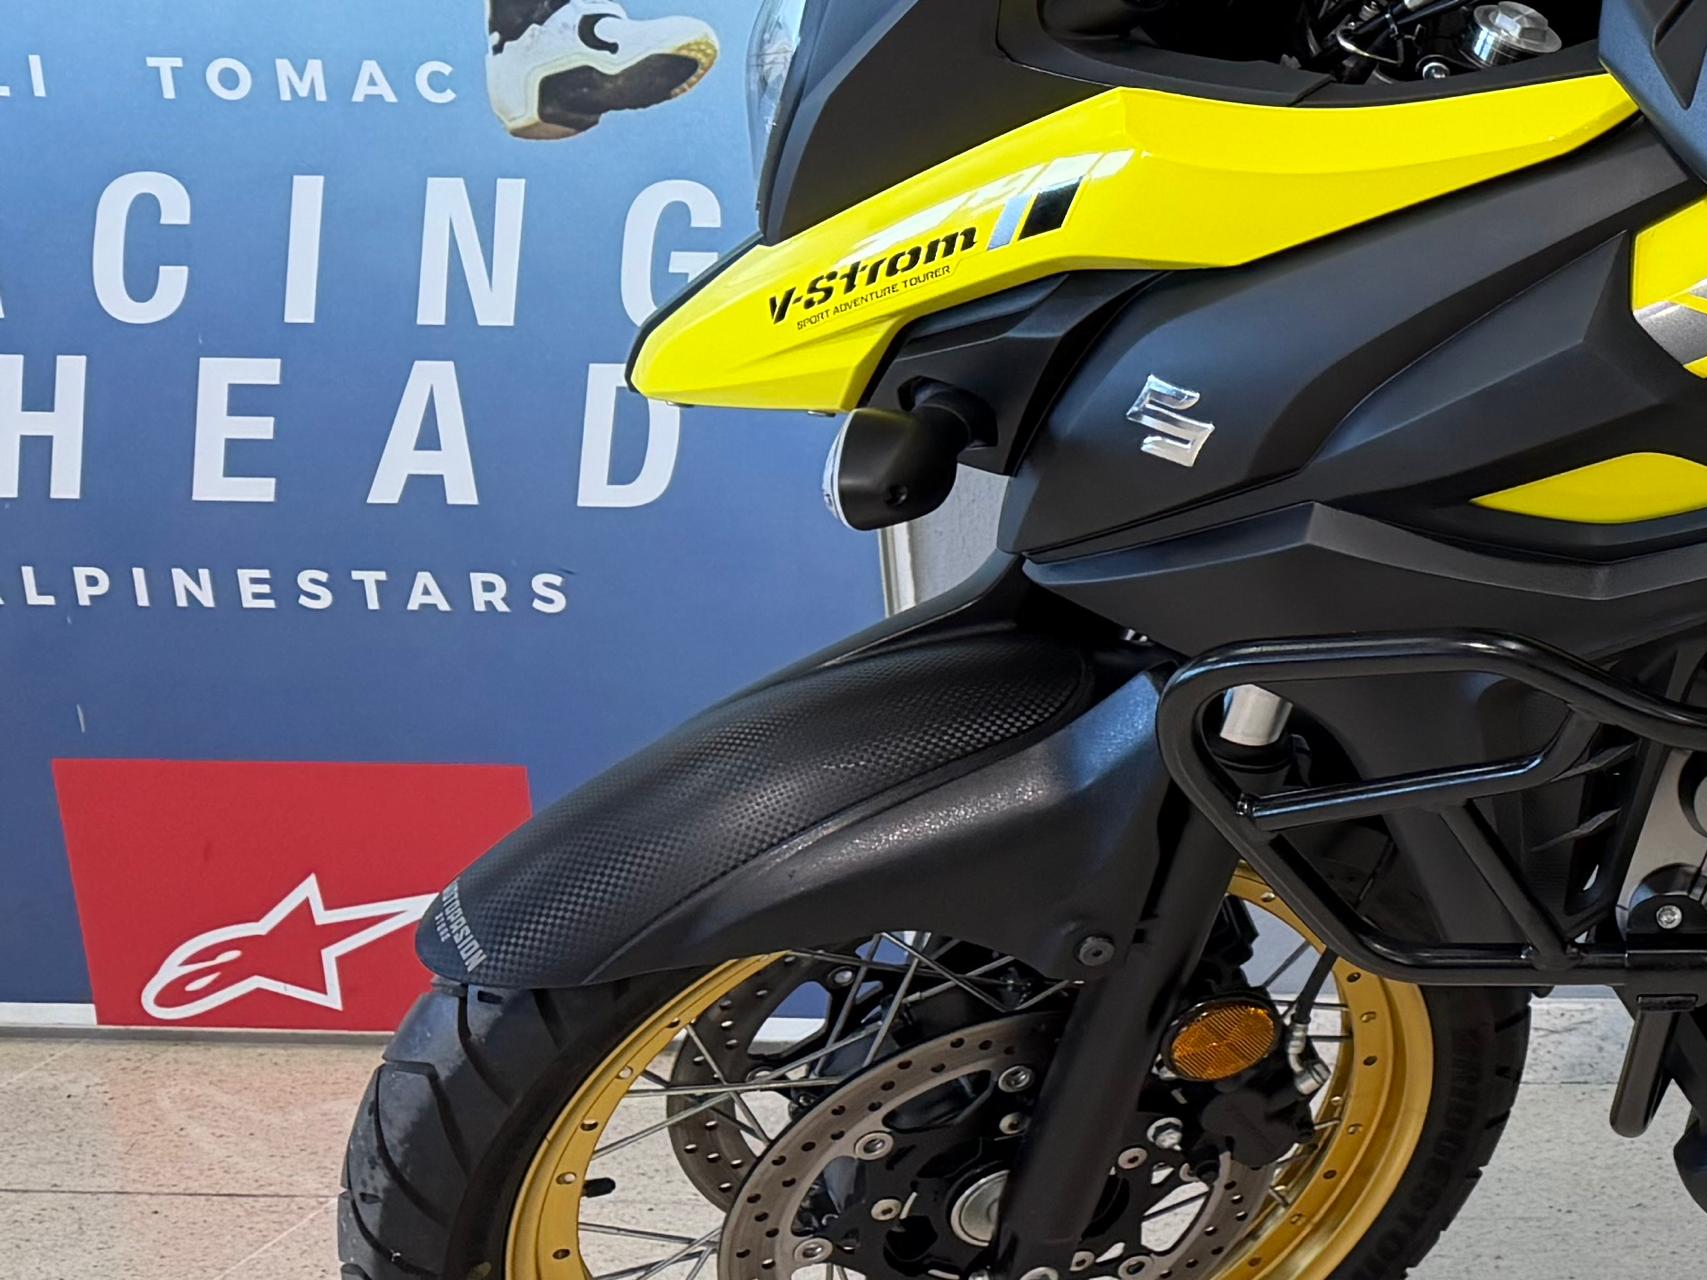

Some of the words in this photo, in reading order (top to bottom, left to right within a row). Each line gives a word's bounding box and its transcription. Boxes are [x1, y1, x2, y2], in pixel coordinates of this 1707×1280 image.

[146, 55, 458, 104] TOMAC
[0, 170, 722, 326] CING
[769, 226, 978, 325] V-Strom
[797, 309, 831, 331] SPORT
[832, 283, 900, 316] ADVENTURE
[902, 264, 952, 290] TOURER
[0, 566, 568, 615] LPINESTARS
